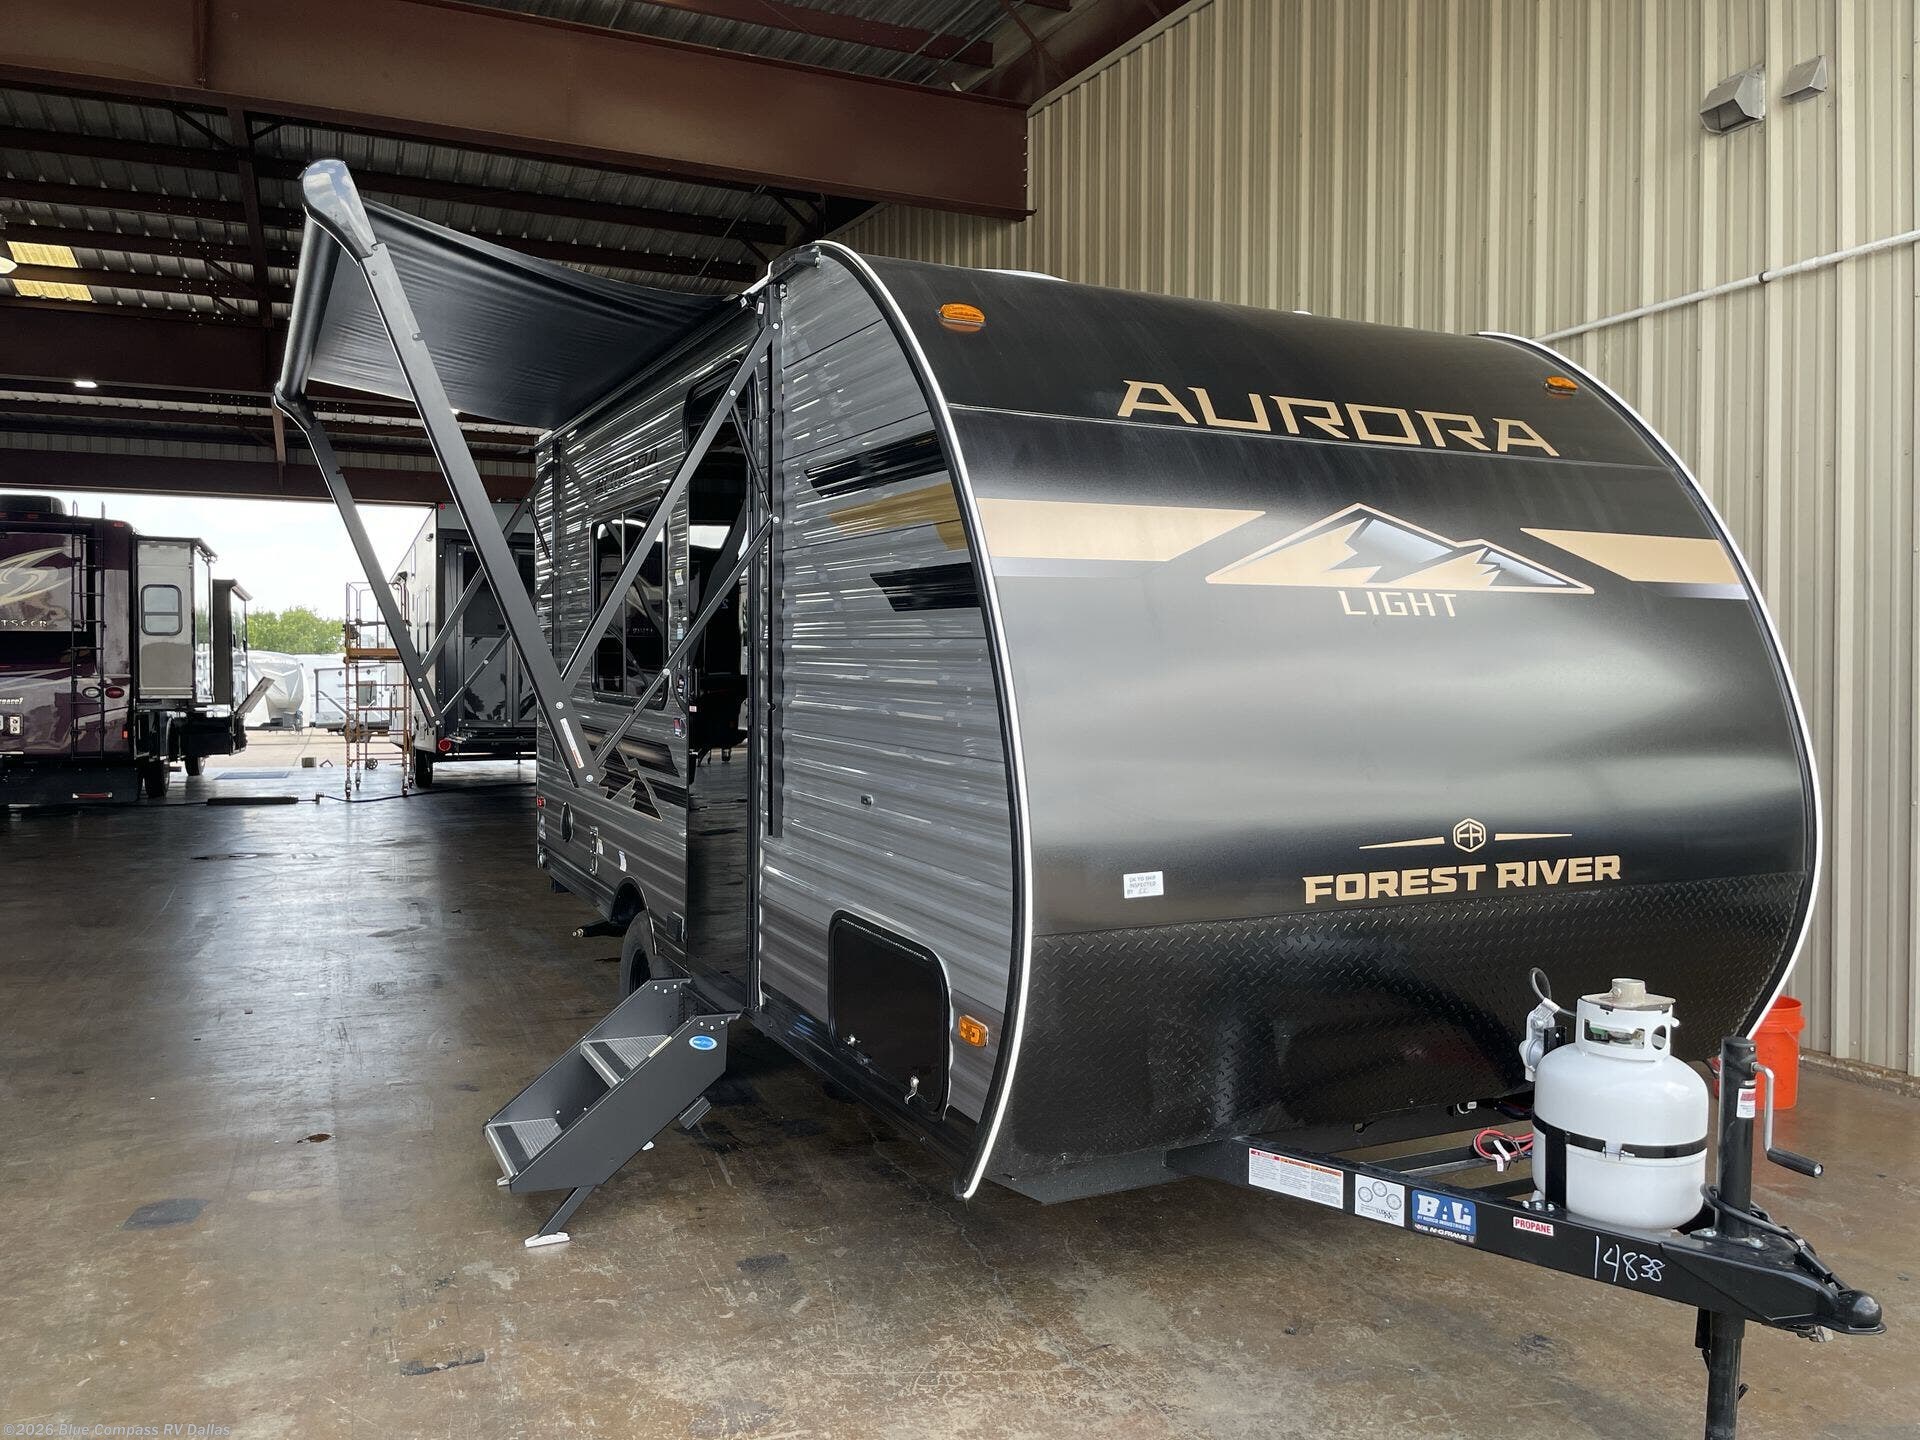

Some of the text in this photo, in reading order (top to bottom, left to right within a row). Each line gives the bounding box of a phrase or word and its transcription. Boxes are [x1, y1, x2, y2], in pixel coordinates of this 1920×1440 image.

[1116, 379, 1561, 457] AURORA
[1337, 590, 1457, 617] LIGHT
[1302, 855, 1621, 904] FOREST RIVER
[1417, 1194, 1472, 1226] BAL
[1514, 1218, 1552, 1234] PROPANE
[1594, 1235, 1666, 1283] 14838
